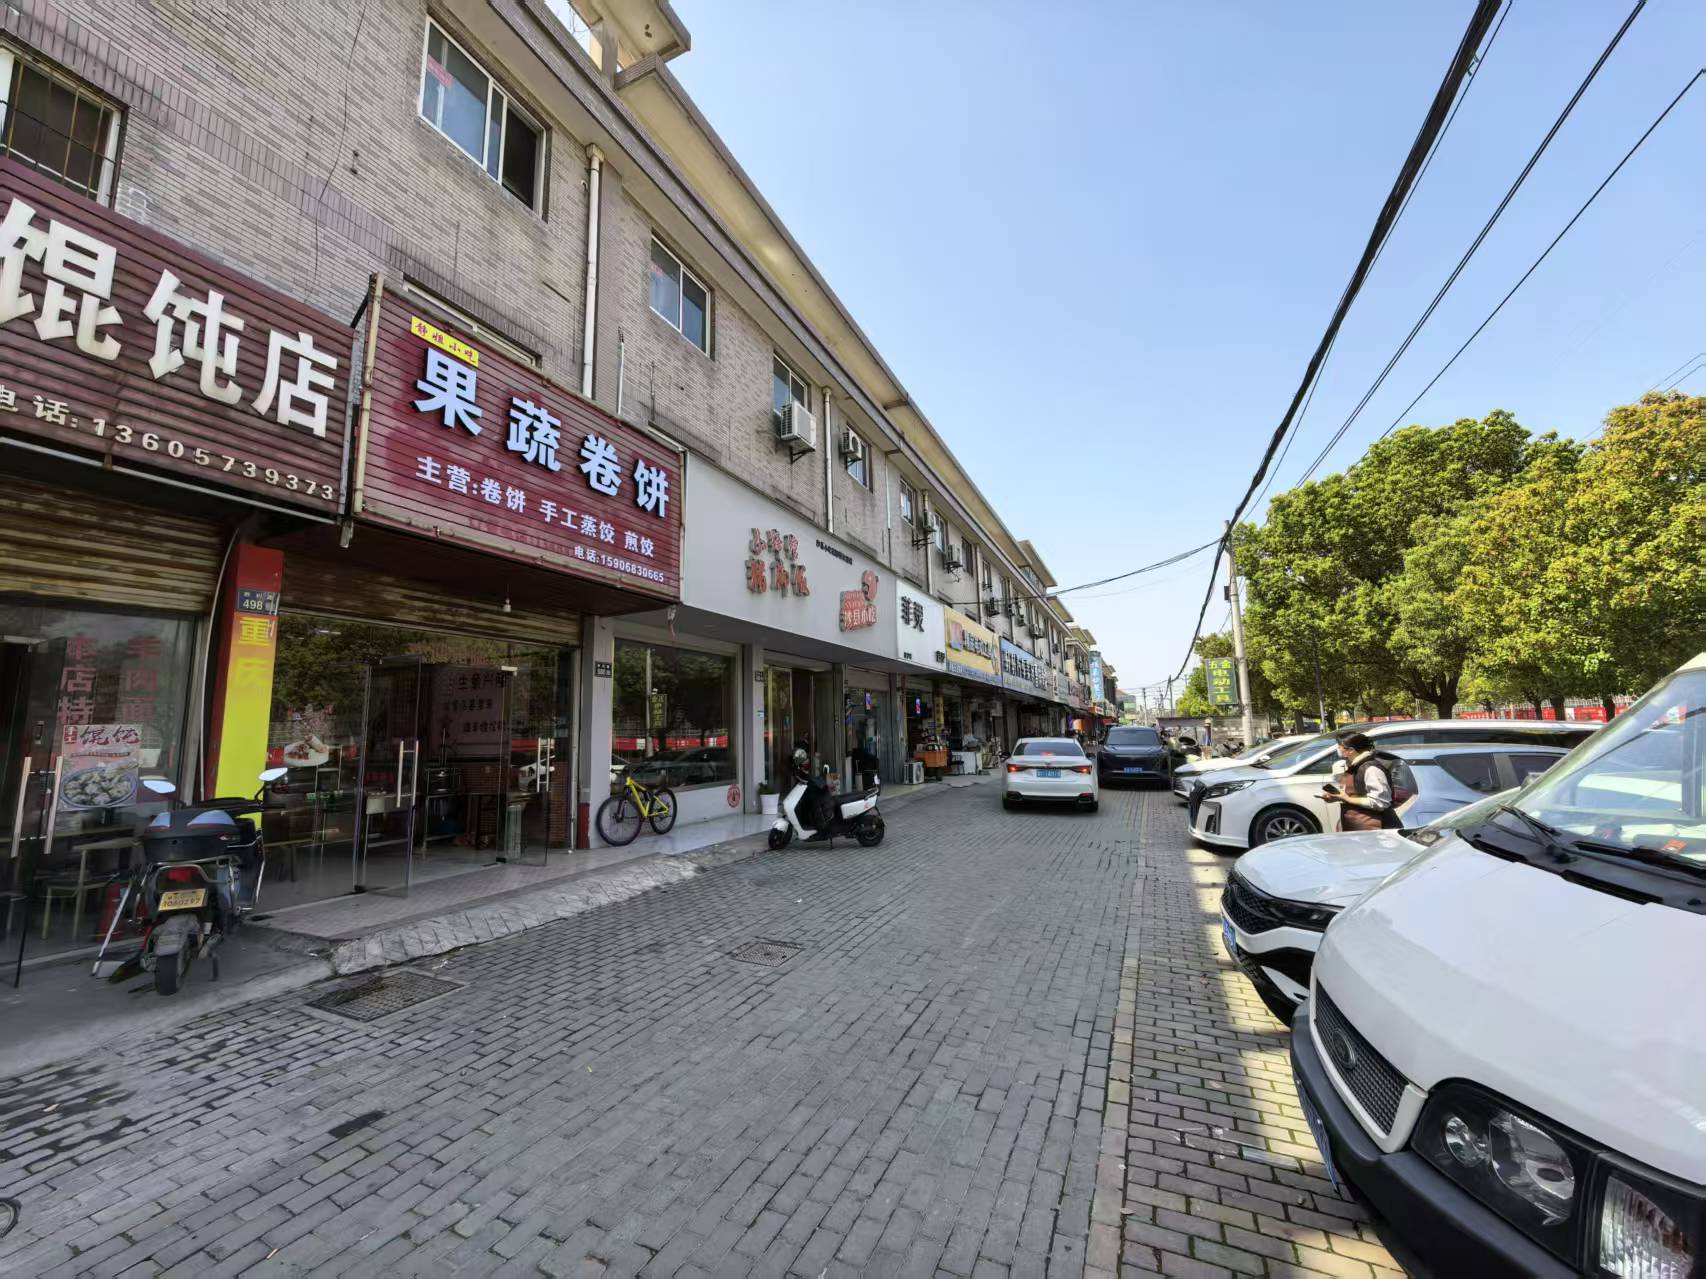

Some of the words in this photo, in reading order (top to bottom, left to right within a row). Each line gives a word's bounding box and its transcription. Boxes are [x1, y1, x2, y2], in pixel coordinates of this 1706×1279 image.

[414, 347, 669, 517] 果蔬卷饼
[539, 500, 615, 544] 手工蒸饺
[624, 531, 654, 558] 煎饺
[243, 599, 263, 611] 498
